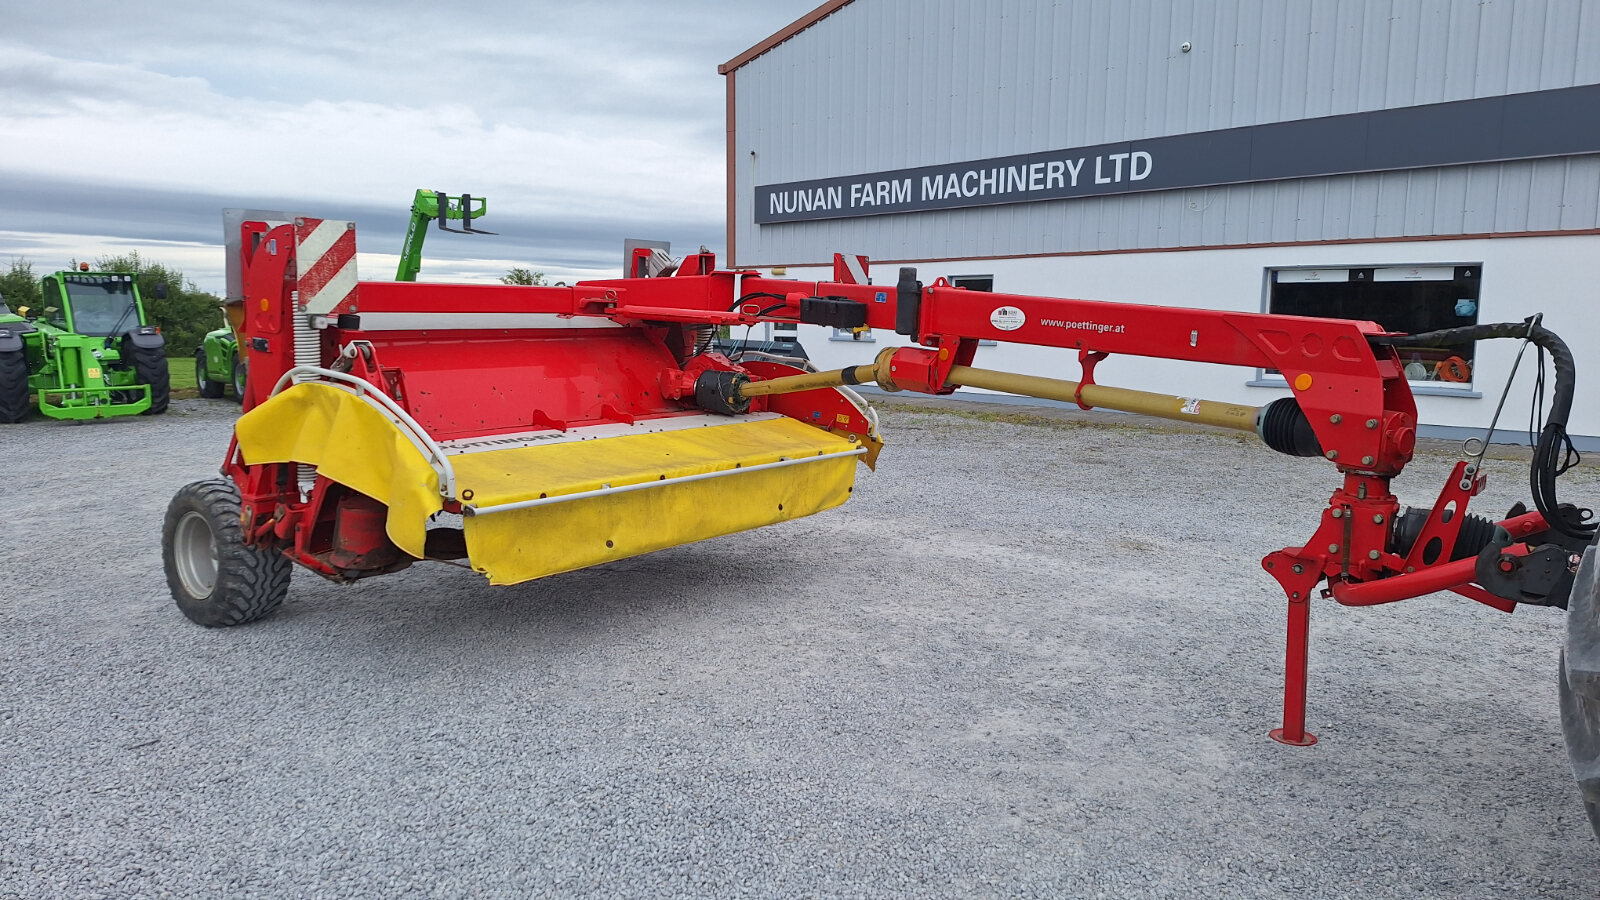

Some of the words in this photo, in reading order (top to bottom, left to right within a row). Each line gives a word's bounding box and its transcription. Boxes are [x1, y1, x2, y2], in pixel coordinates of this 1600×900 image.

[769, 186, 842, 215] NUNAN
[850, 178, 912, 208] FARM
[921, 157, 1086, 201] MACHINERY
[1095, 151, 1153, 185] LTD
[1040, 318, 1126, 334] www.poettinger.at
